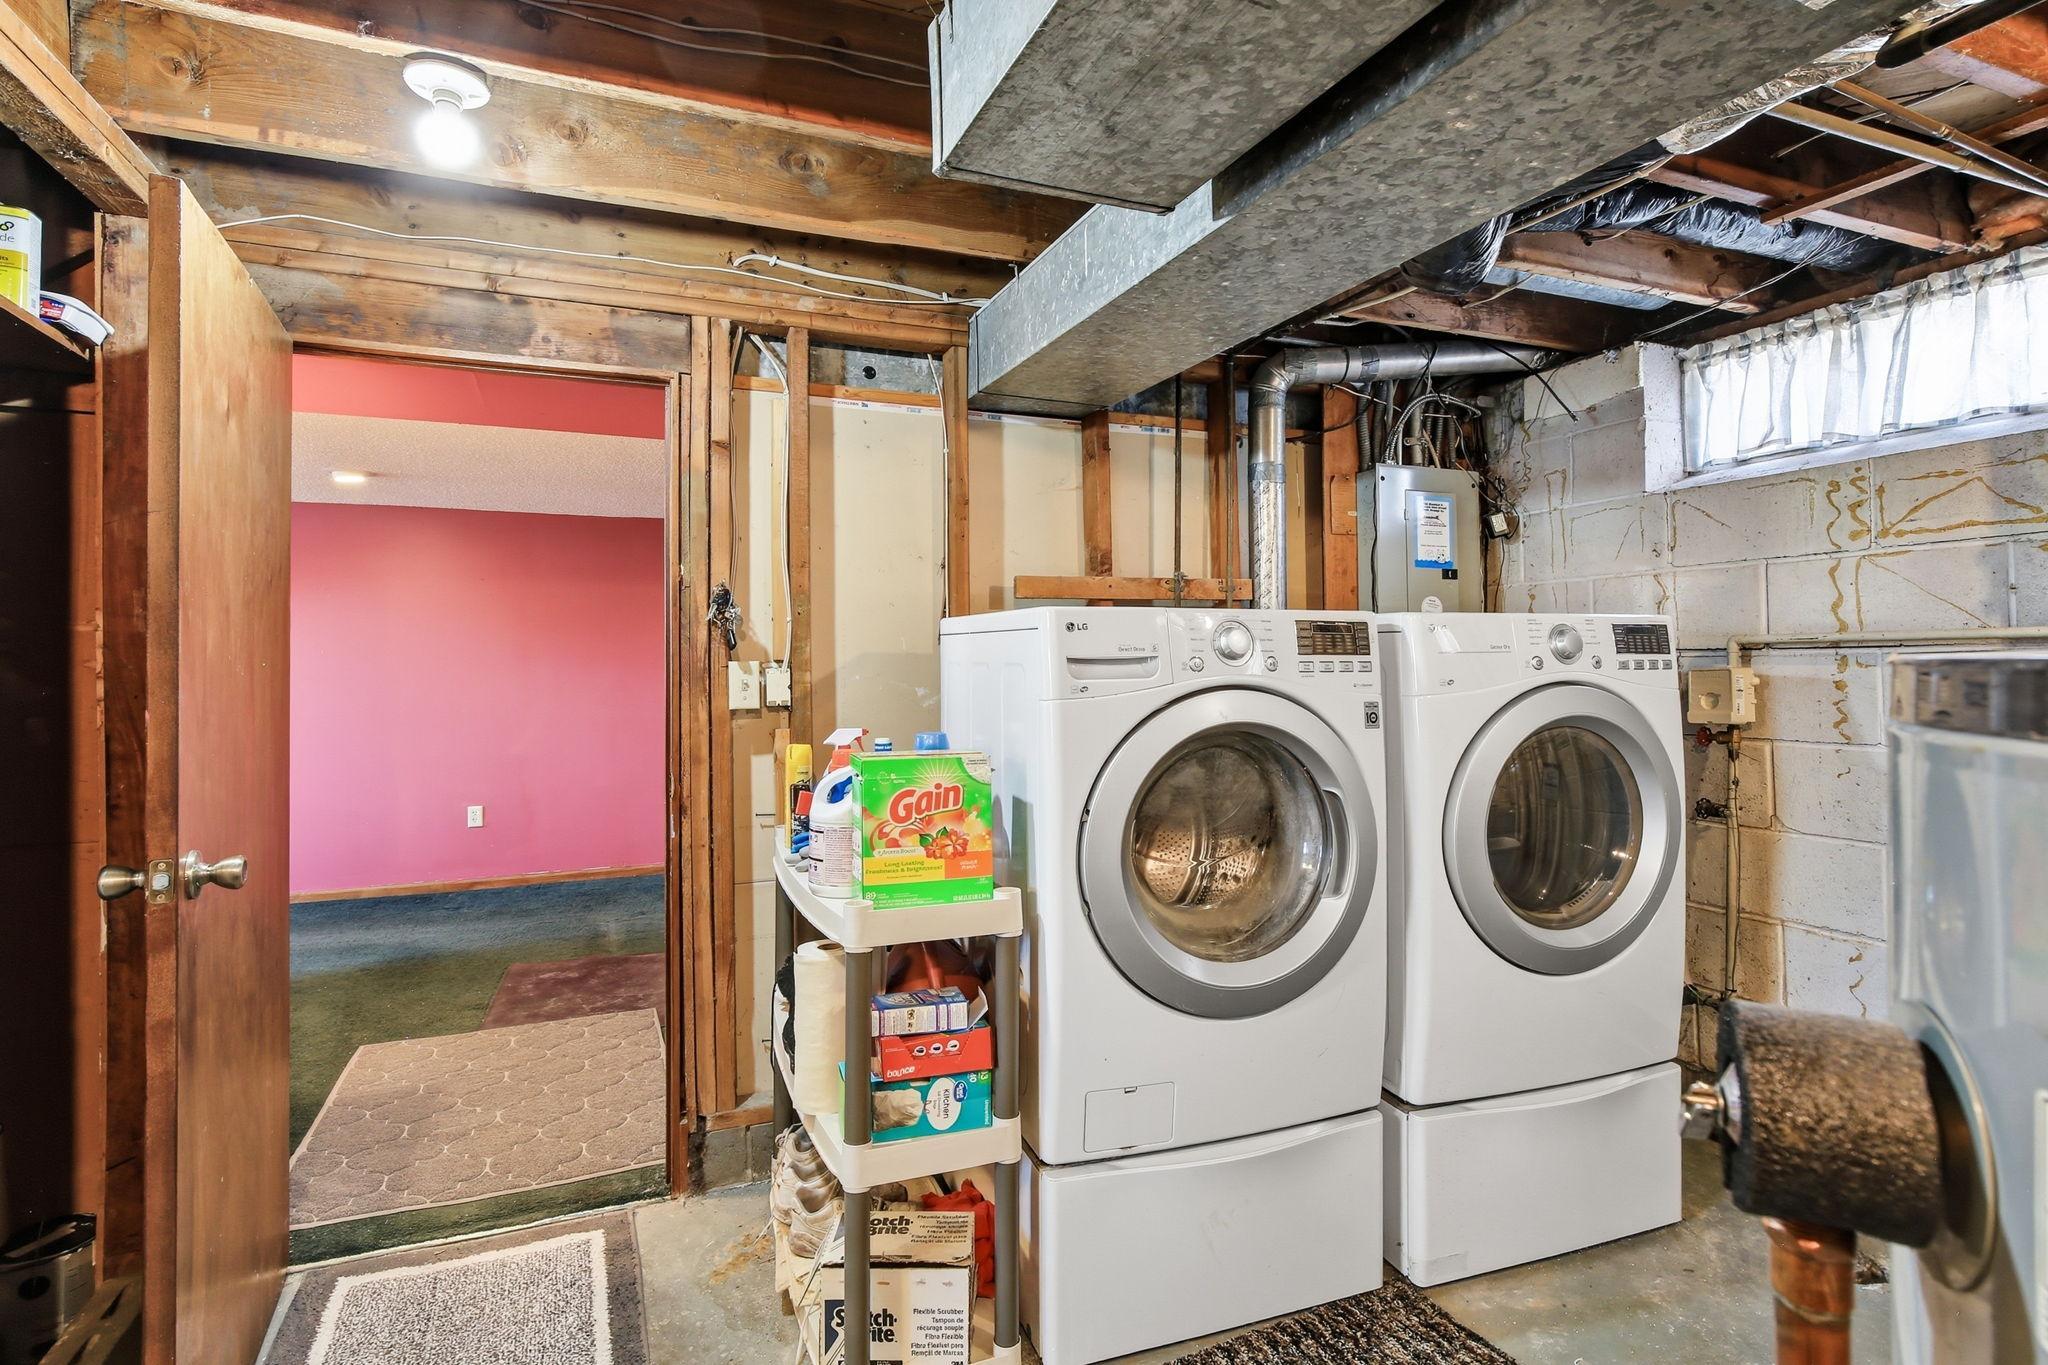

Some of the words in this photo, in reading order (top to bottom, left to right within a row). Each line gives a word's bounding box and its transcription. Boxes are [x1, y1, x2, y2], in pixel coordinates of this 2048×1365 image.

[1077, 623, 1089, 631] LG
[889, 782, 961, 825] Gain
[886, 1066, 916, 1078] bounce
[931, 1317, 955, 1325] Tampon
